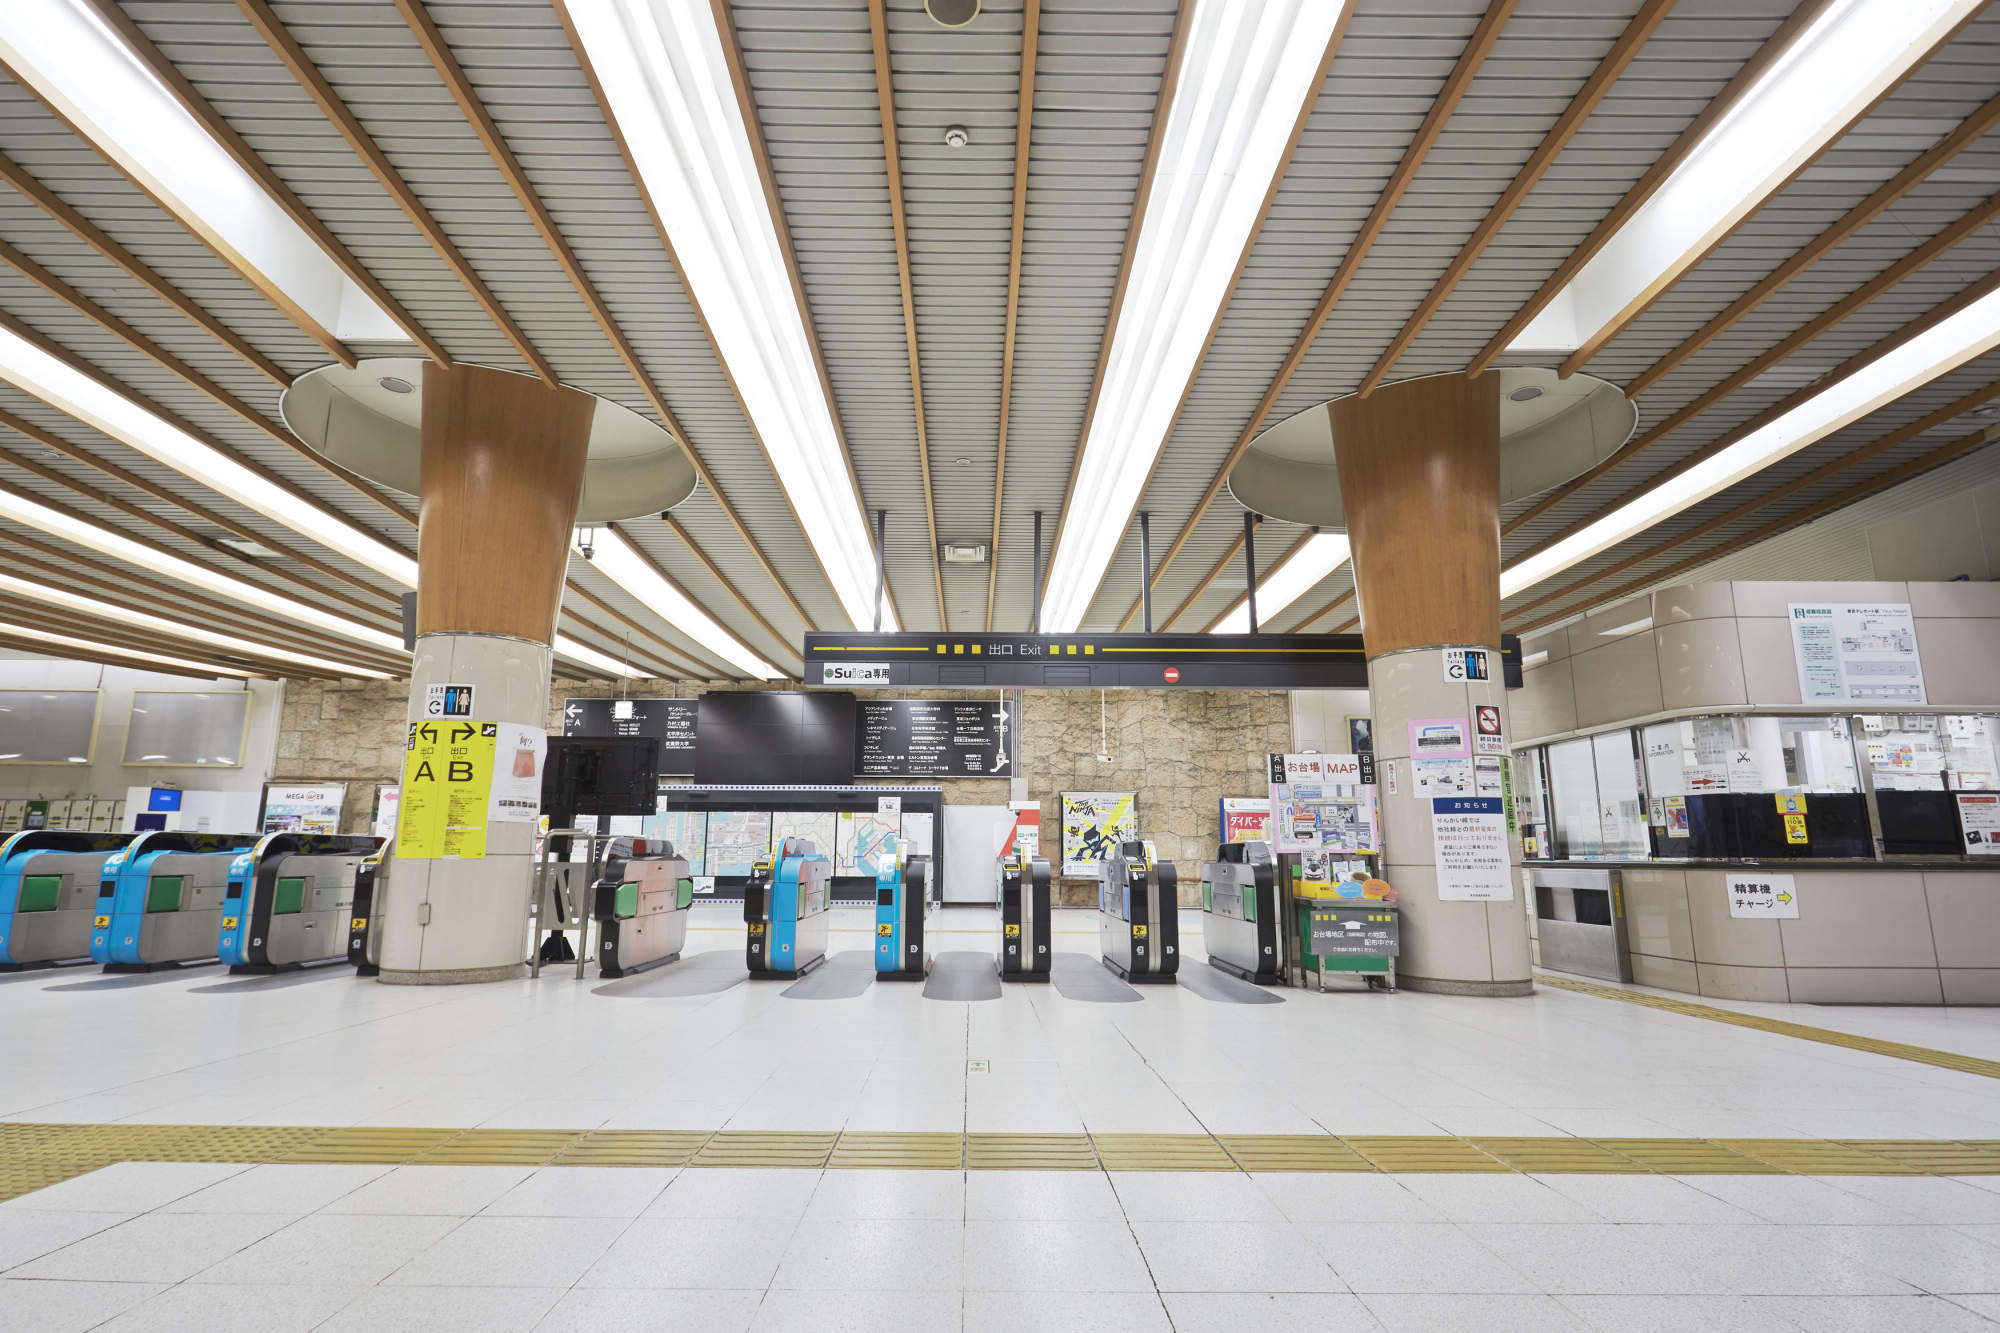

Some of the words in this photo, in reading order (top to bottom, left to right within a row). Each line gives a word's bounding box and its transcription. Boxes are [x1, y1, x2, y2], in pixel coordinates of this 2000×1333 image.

[988, 643, 1013, 655] 出口
[1020, 643, 1042, 655] Exit
[450, 747, 468, 755] 出口
[414, 761, 436, 782] A
[448, 761, 473, 782] B
[1288, 762, 1320, 773] お台場
[1327, 763, 1358, 774] MAP
[1734, 883, 1771, 894] 精算機
[1736, 898, 1774, 909] チャージ
